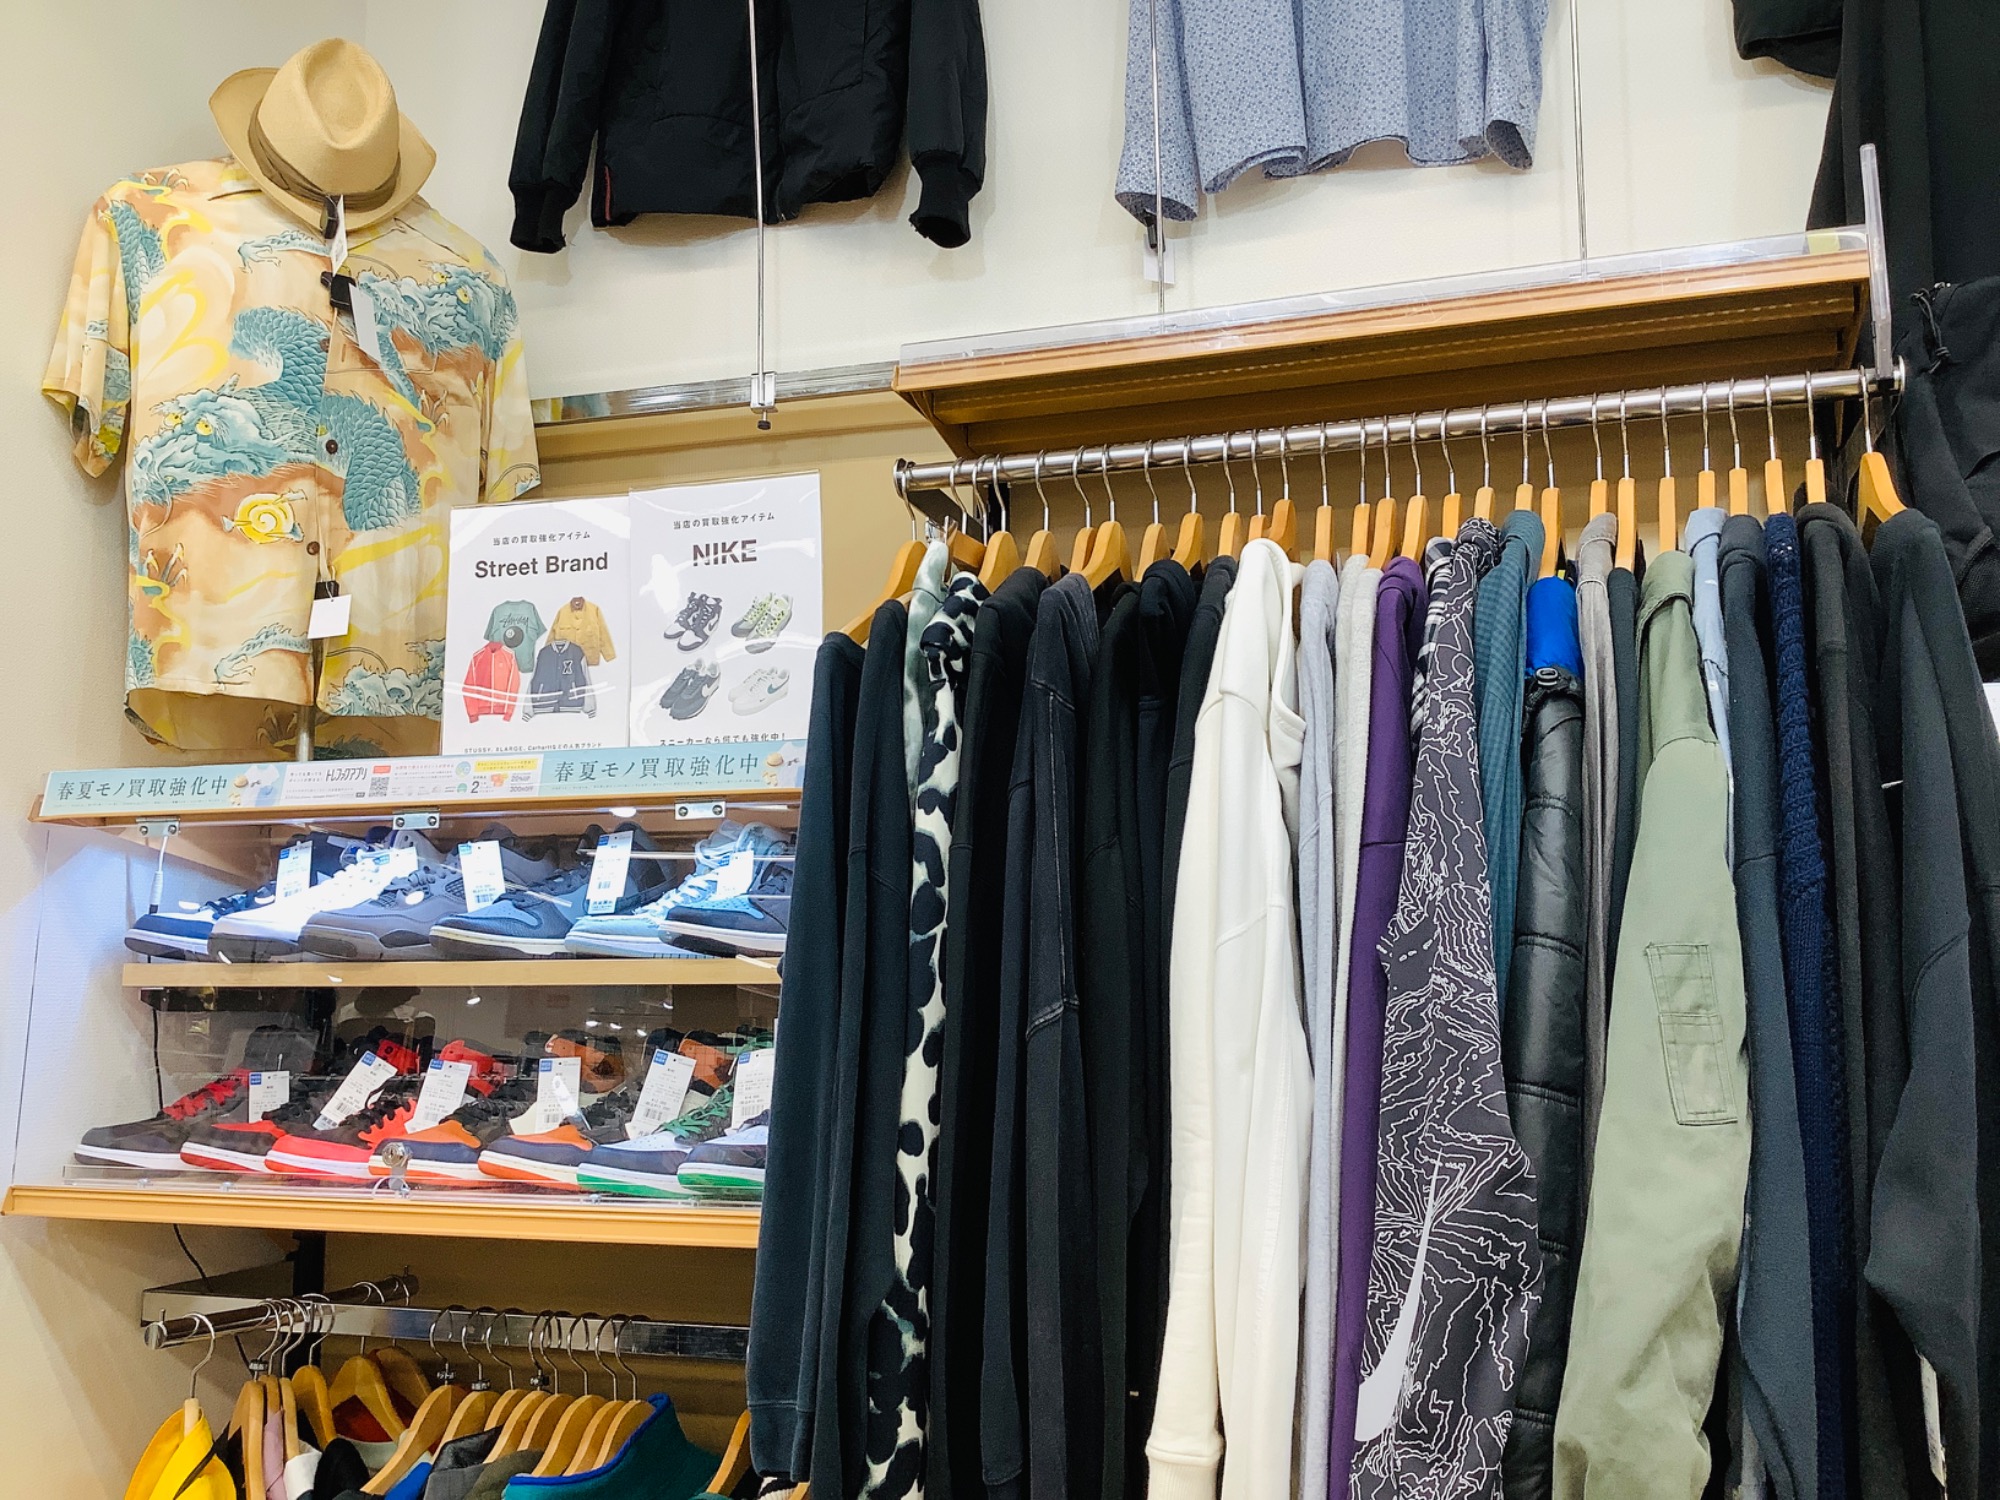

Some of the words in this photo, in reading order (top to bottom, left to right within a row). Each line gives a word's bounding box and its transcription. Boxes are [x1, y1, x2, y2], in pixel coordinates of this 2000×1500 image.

[673, 512, 775, 530] 当店の買取強化アイテム
[493, 531, 590, 546] 当店の買取強化アイテム
[474, 557, 538, 579] Street
[545, 551, 608, 574] Brand
[692, 539, 758, 567] NIKE
[554, 753, 759, 783] 春夏モノ買取強化中
[57, 775, 228, 801] 春夏モノ買取強化中
